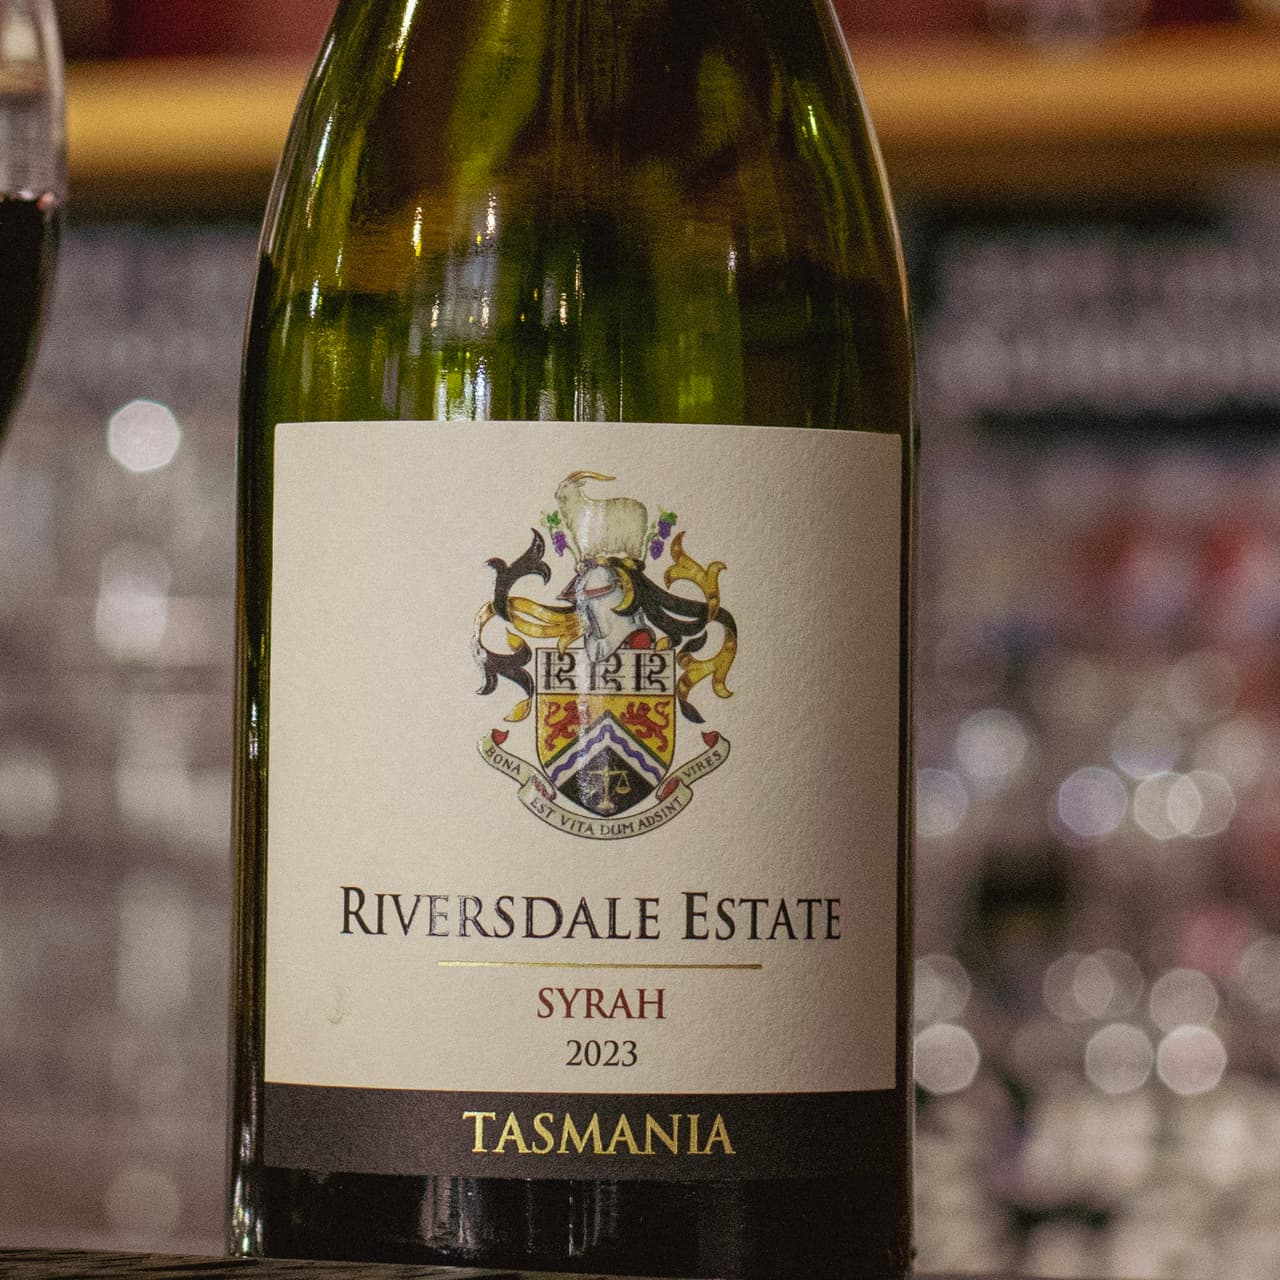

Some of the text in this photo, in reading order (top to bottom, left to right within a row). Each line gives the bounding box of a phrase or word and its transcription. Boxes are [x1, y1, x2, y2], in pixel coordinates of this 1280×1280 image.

[485, 747, 723, 836] BONA EST VITA DUM ADSINT VIRES
[339, 886, 842, 941] RIVERSDALE ESTATE
[536, 987, 667, 1020] SYRAH
[565, 1039, 639, 1068] 2023
[462, 1110, 737, 1156] TASMANIA
